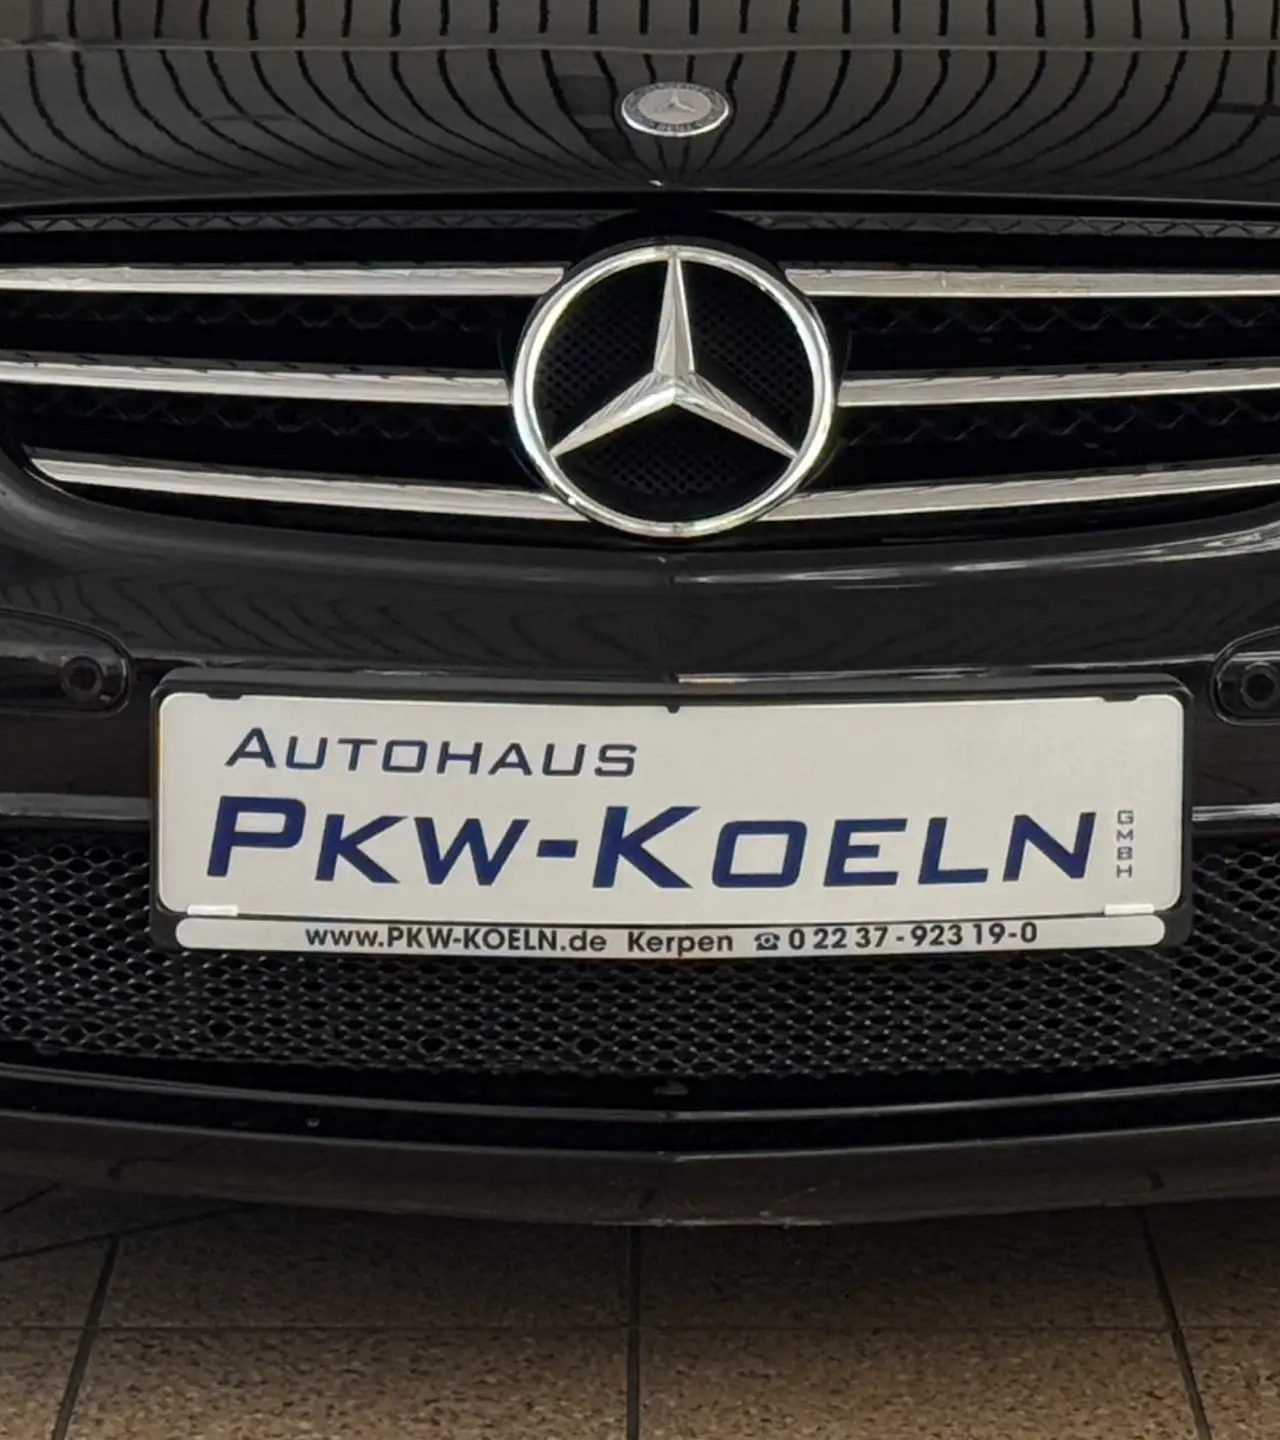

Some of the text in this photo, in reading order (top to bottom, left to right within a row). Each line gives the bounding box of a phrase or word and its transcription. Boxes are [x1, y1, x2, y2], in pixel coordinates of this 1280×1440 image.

[224, 727, 637, 778] AUTOHAUS
[206, 795, 1097, 889] PKW-KOELN
[305, 926, 607, 952] www.PKW-KOELN.de
[627, 930, 733, 958] Kerpen
